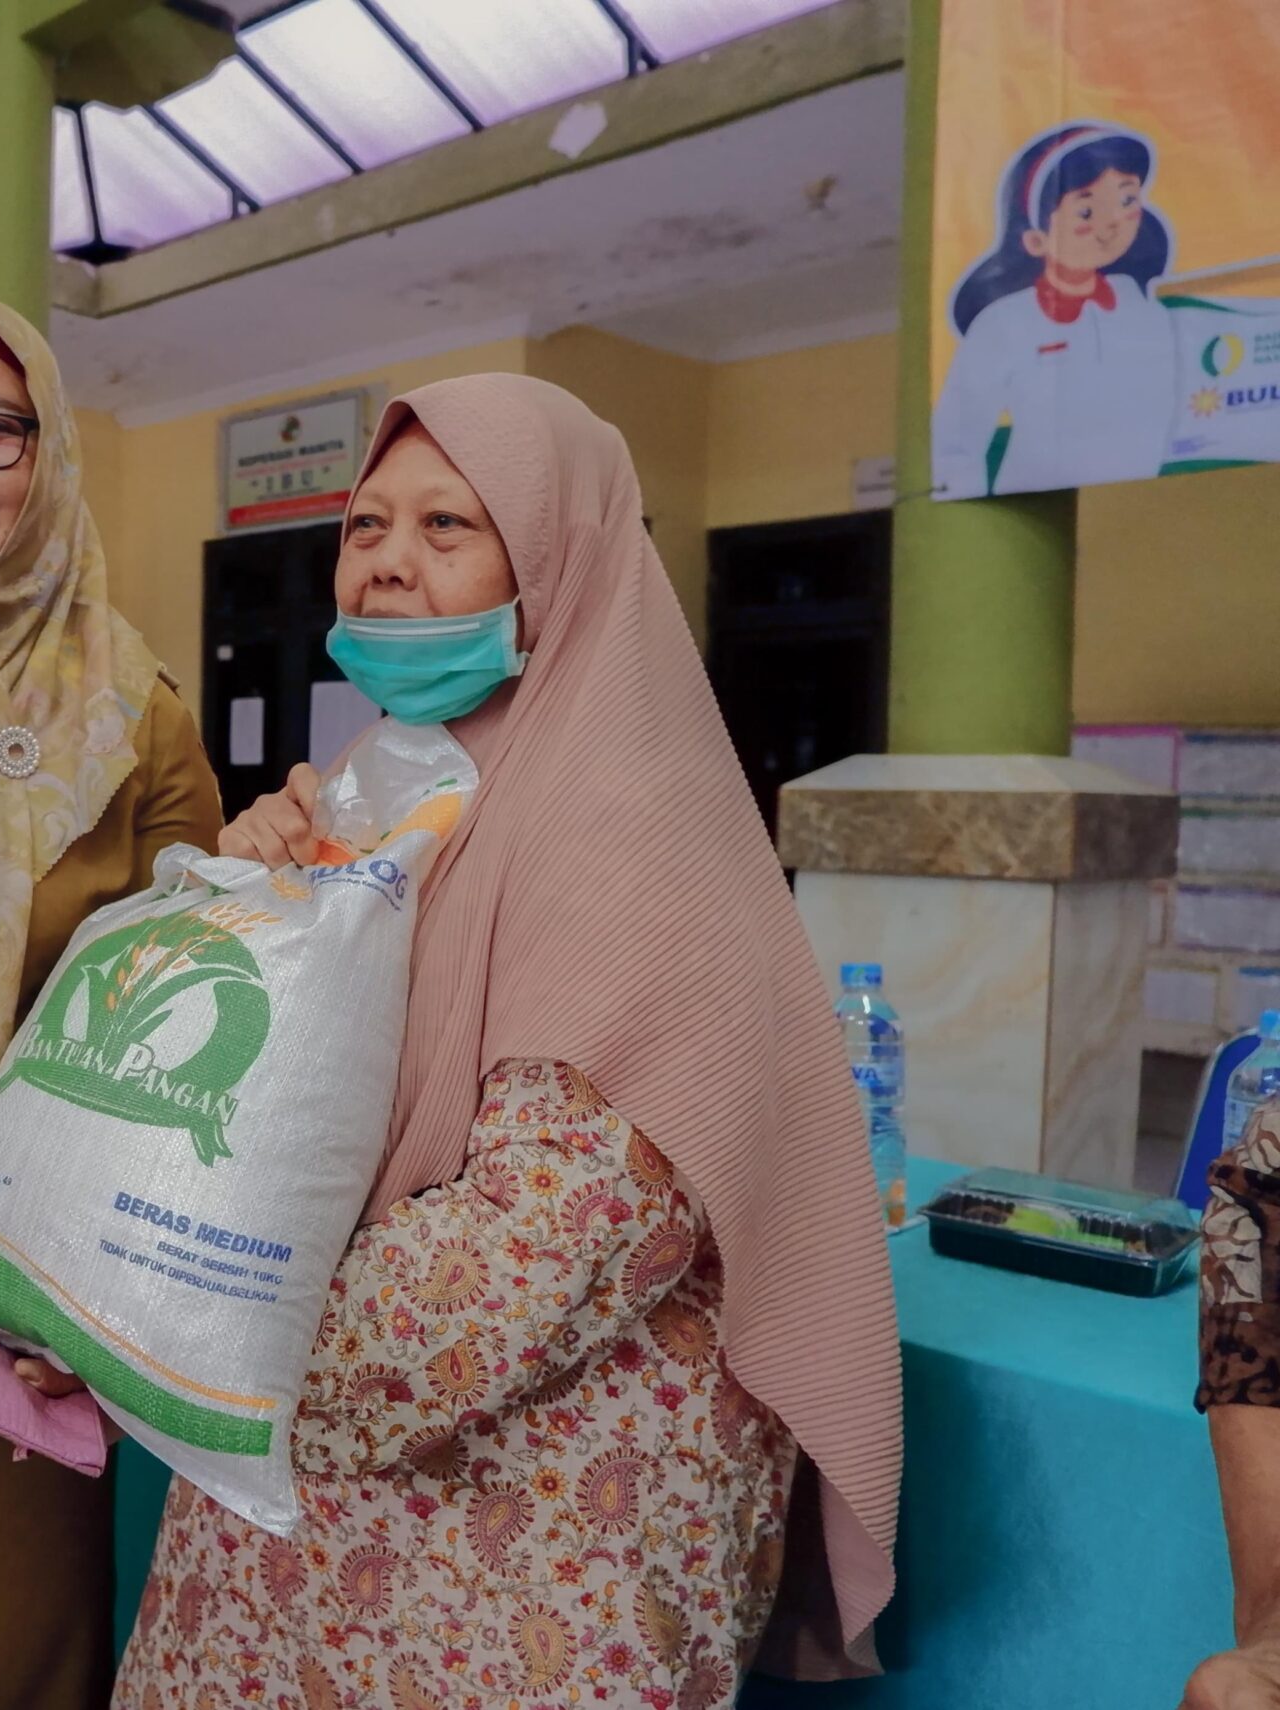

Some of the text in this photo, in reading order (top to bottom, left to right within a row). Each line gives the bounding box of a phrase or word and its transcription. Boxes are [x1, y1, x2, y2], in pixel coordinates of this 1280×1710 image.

[113, 1191, 292, 1263] BERAS MEDIUM
[156, 1241, 200, 1264] BERAT
[99, 1239, 278, 1304] TIDAK UNTUK DIPERJUALBELIKAN
